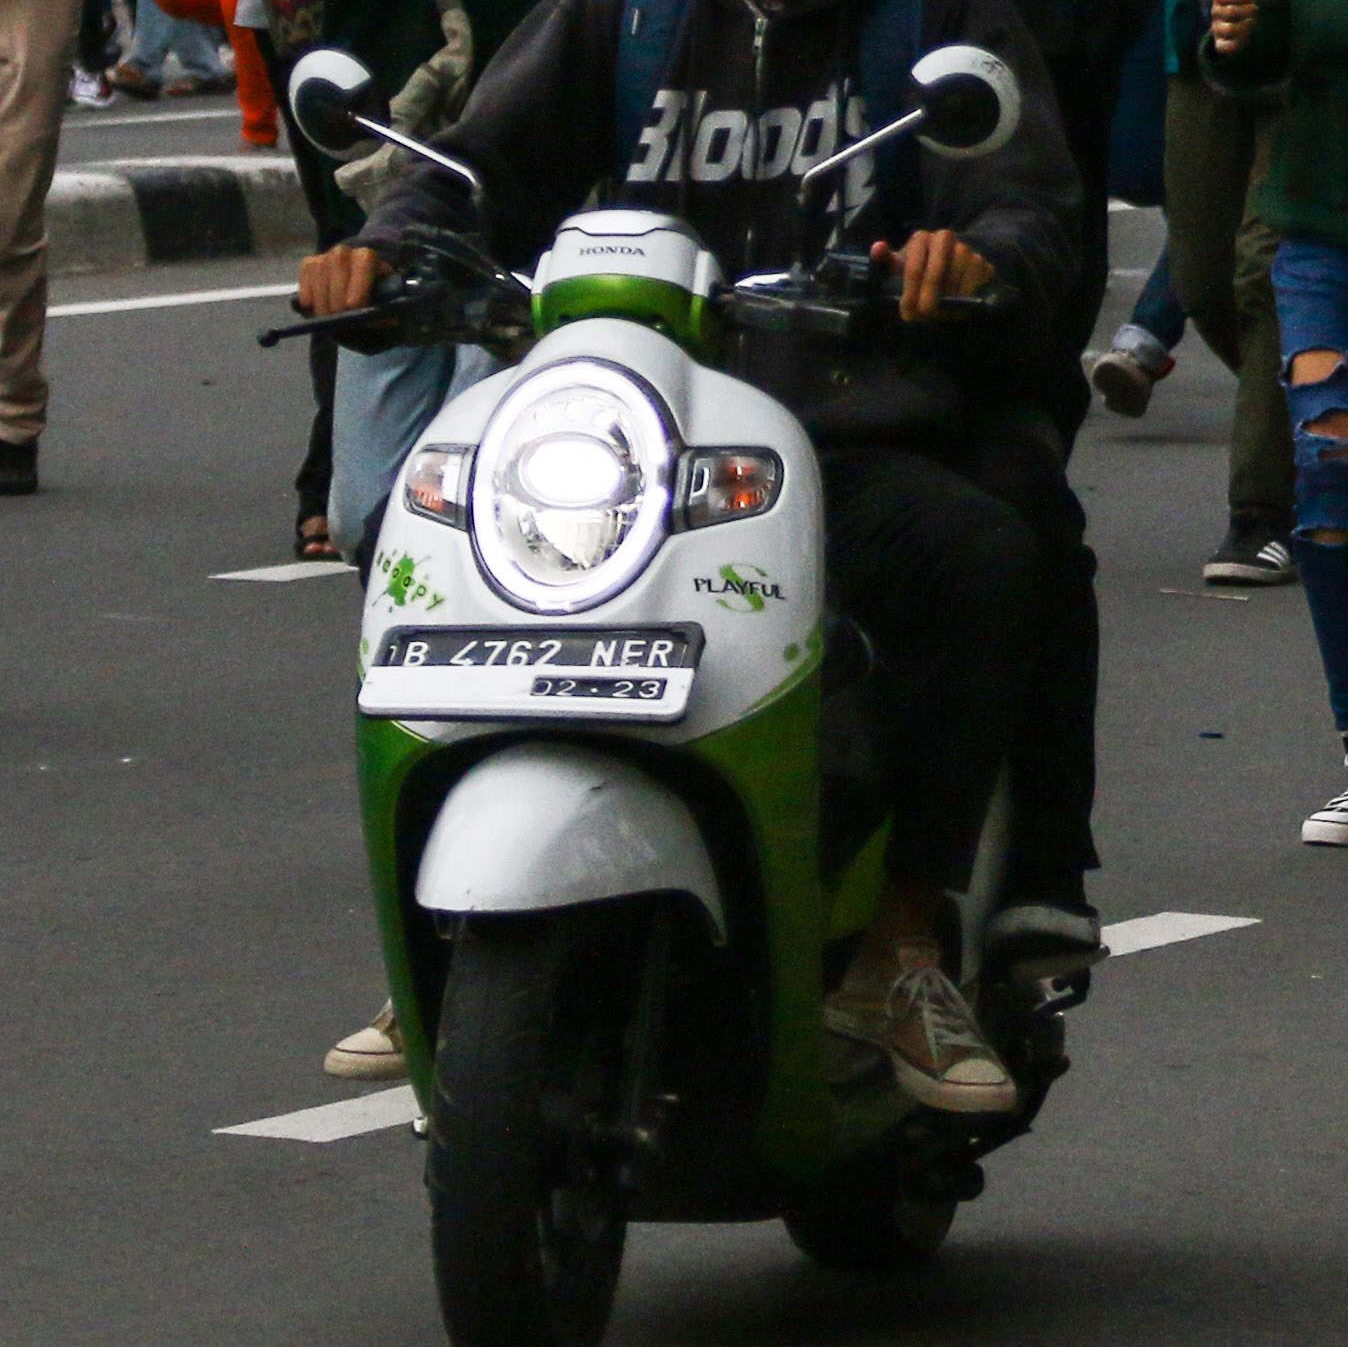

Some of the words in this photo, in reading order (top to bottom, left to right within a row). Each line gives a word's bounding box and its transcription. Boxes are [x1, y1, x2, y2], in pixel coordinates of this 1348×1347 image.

[579, 245, 646, 257] HONDA
[693, 577, 786, 600] PLAYFUL
[402, 640, 429, 667] B
[449, 639, 562, 667] 4762
[590, 639, 674, 668] NER
